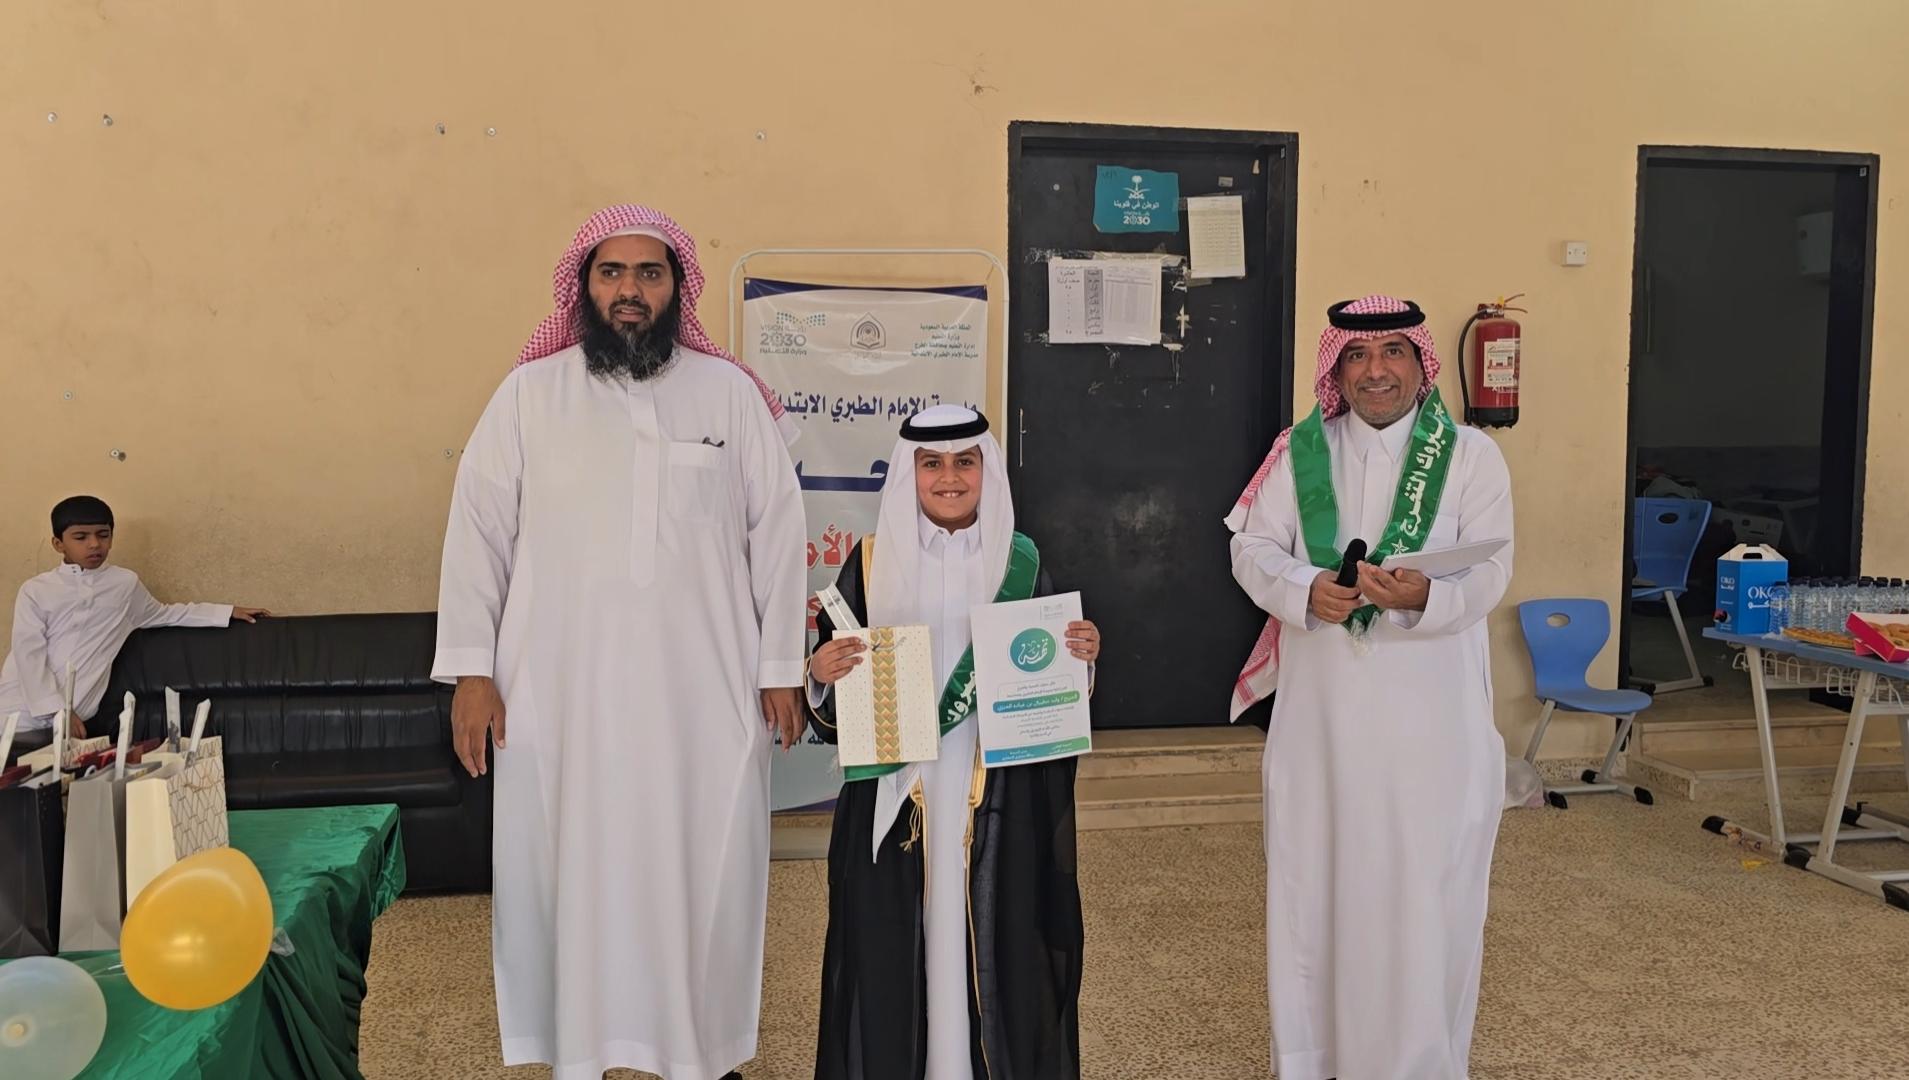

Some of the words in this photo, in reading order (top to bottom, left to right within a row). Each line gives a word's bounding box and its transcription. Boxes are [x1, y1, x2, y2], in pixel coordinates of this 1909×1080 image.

[1131, 200, 1141, 210] في
[1123, 215, 1151, 226] 2030
[760, 332, 807, 347] 2030
[831, 394, 883, 423] الطبري
[1400, 470, 1429, 538] التخرج
